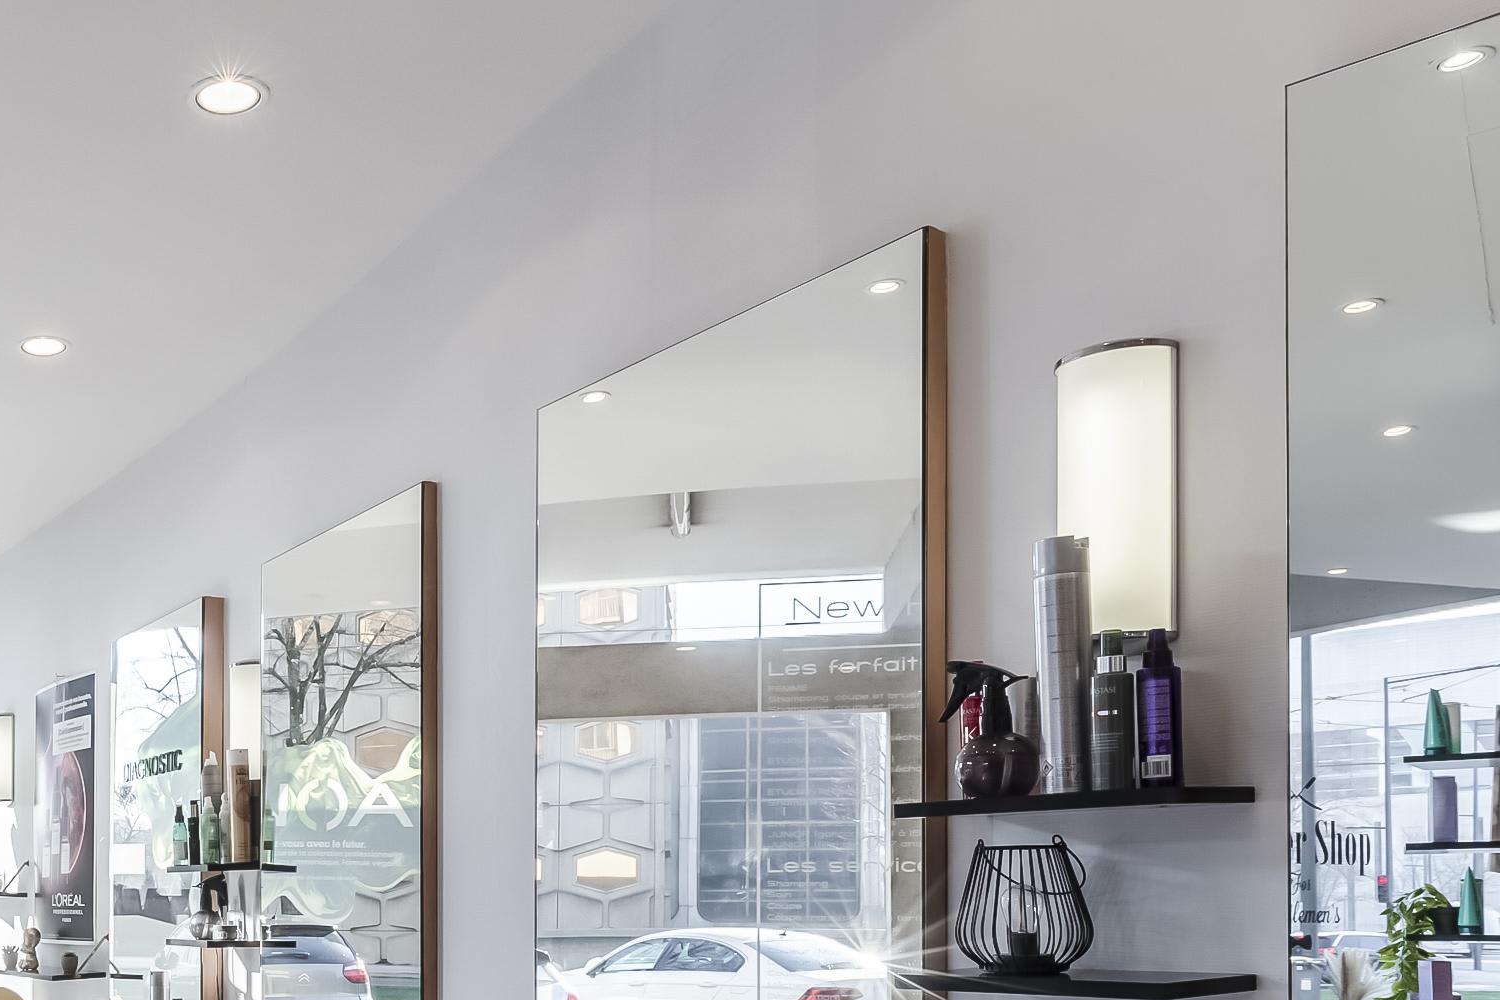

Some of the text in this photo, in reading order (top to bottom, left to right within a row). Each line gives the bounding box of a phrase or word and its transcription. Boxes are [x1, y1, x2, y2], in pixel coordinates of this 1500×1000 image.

[792, 595, 885, 621] New
[767, 656, 920, 677] Les forfait
[123, 749, 183, 783] DIAGNOSTIC
[1314, 820, 1372, 877] Shop
[766, 857, 817, 874] Les
[51, 892, 86, 907] L'ORÉAL
[1292, 900, 1341, 924] lemen's
